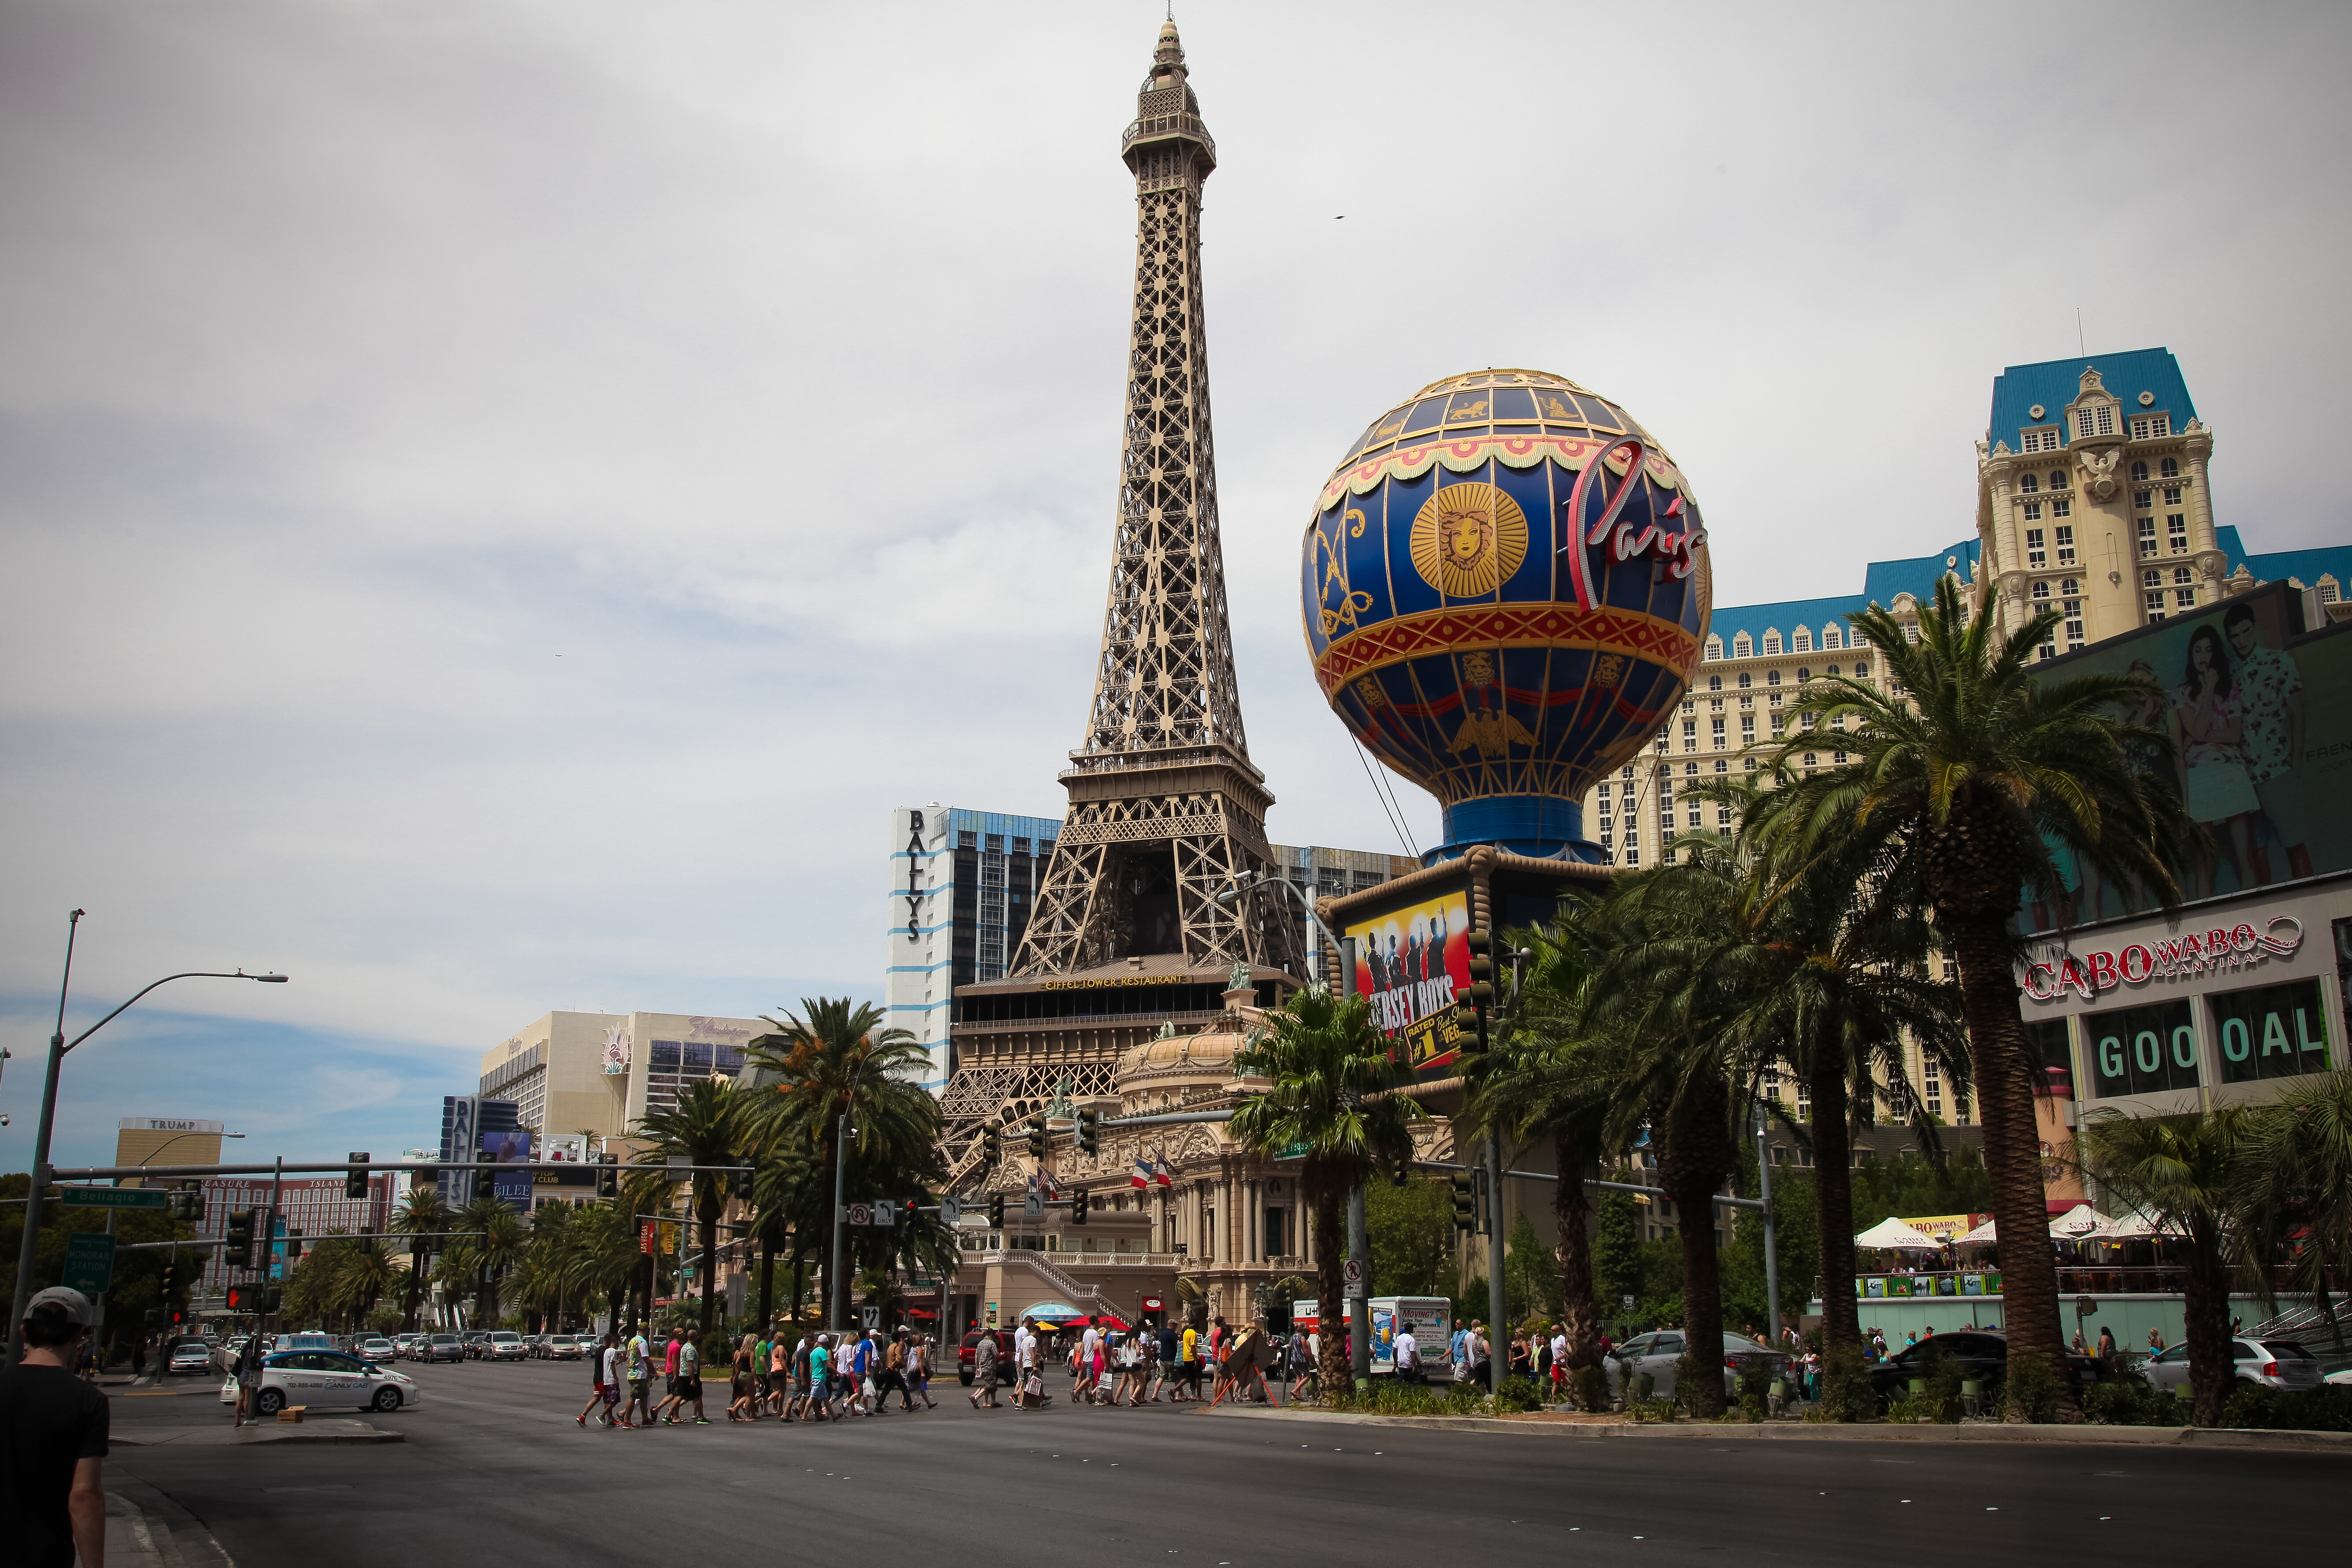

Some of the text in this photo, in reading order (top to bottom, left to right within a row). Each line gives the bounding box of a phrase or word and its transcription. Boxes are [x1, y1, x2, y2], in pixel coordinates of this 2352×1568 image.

[1568, 434, 1708, 613] Paris
[905, 811, 925, 940] BALLYS
[2022, 924, 2259, 1000] CABO WABO
[2165, 954, 2256, 977] CANTINA
[1046, 975, 1182, 990] EIFFEL TOWER RESTAURANT
[1417, 974, 1455, 1019] BOYS
[689, 1016, 749, 1039] Flamingo
[1408, 1018, 1435, 1037] RATED
[1437, 1016, 1451, 1031] Best
[151, 1120, 195, 1130] TRUMP
[200, 1179, 345, 1189] REASURE ISLAND
[494, 1184, 530, 1197] BILEE
[79, 1191, 135, 1204] Bellagio
[68, 1250, 110, 1260] MONORAIL
[71, 1261, 106, 1271] STATION
